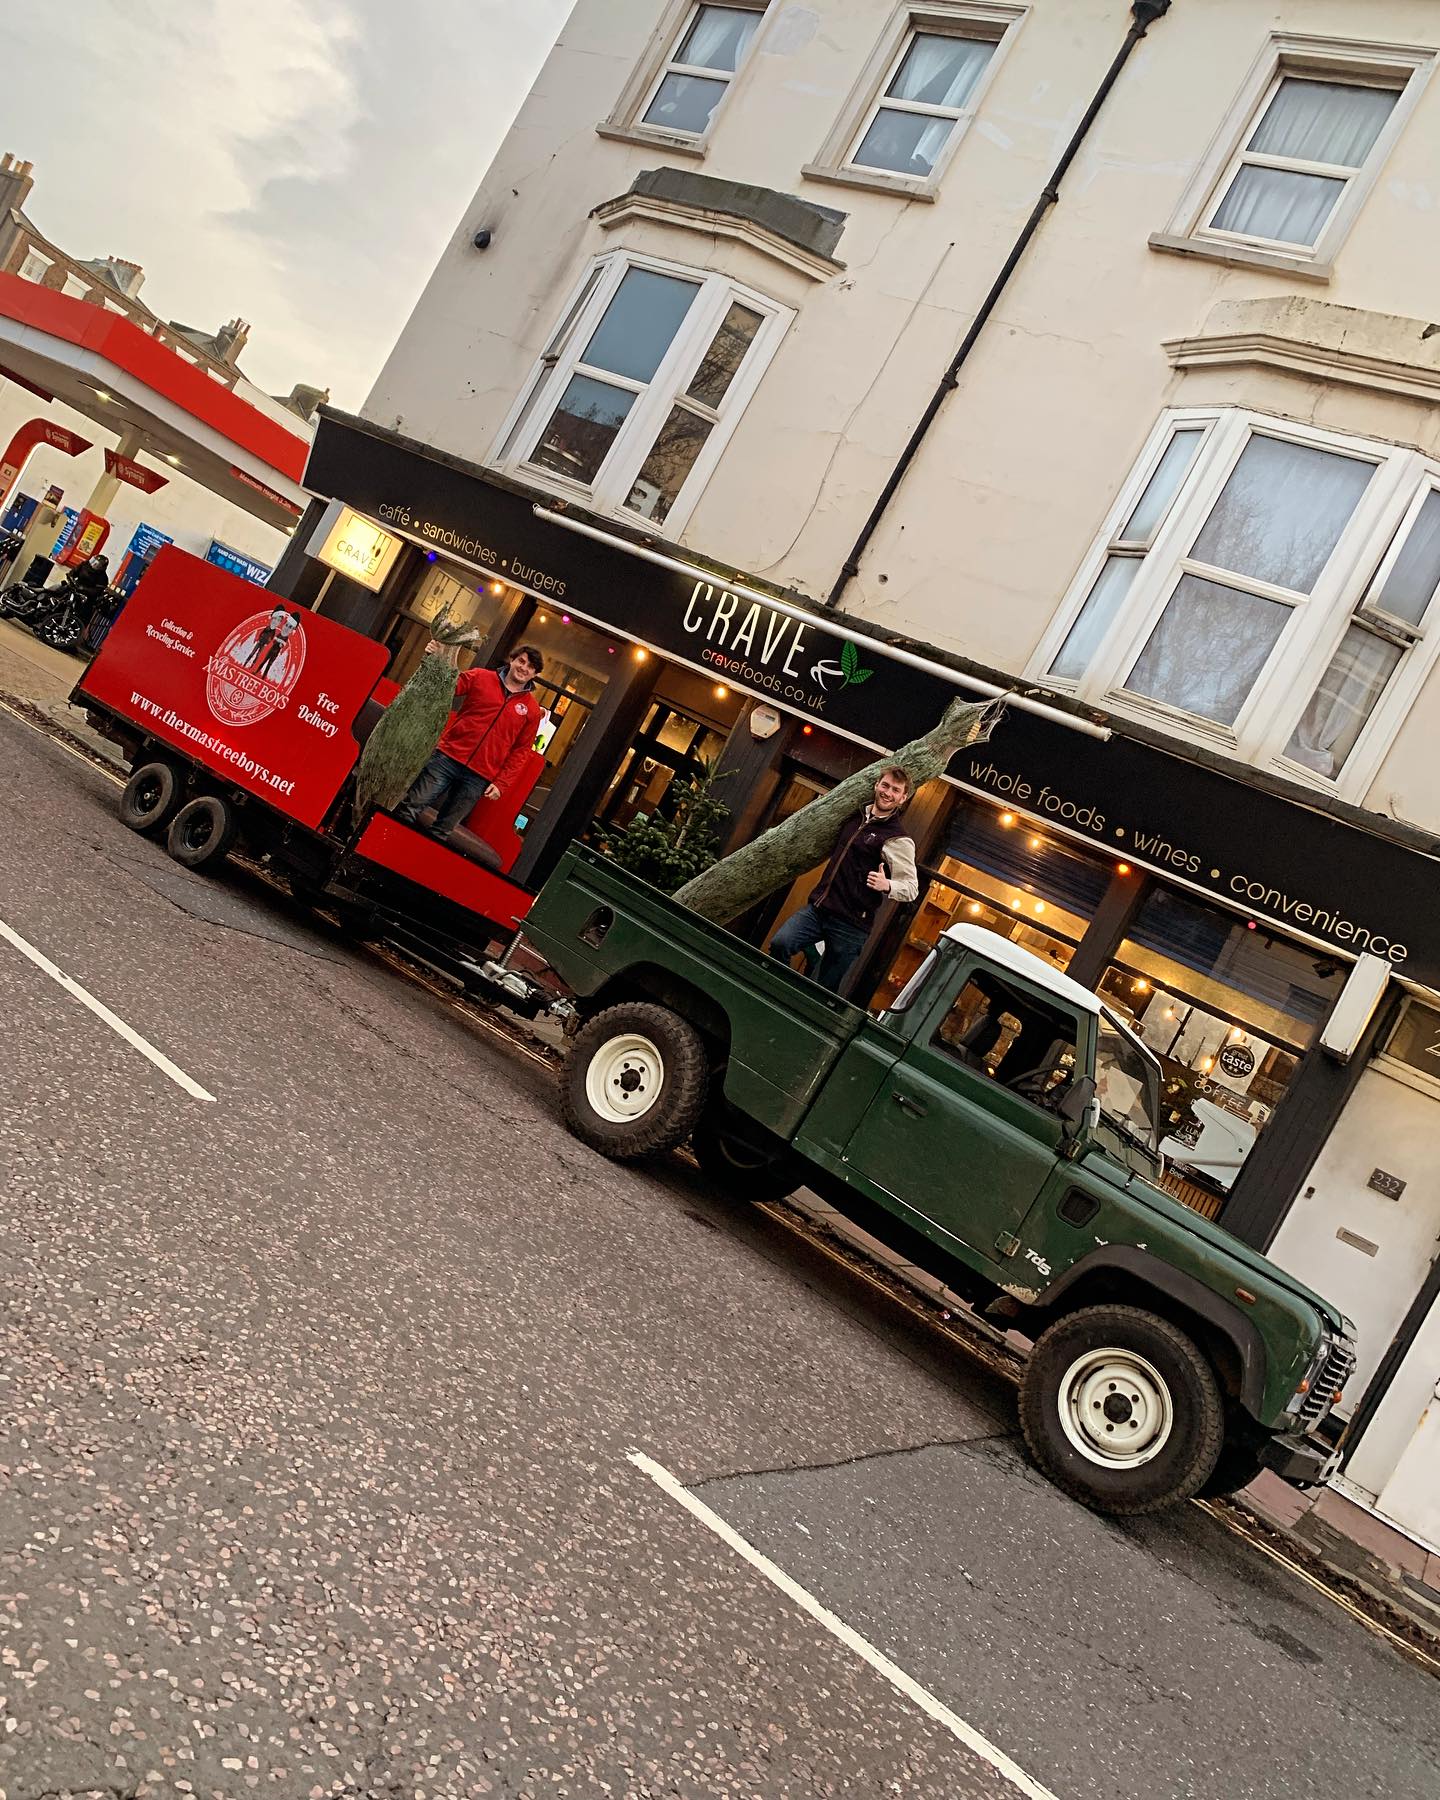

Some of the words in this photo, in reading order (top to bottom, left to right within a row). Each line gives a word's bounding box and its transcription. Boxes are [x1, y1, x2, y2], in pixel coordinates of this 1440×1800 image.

[336, 540, 376, 570] CRAVE
[379, 502, 410, 526] caffé
[422, 520, 497, 564] sandwiches
[512, 557, 566, 596] burgers
[145, 624, 173, 648] Recycling
[172, 640, 196, 658] Service
[161, 618, 187, 638] Collection
[683, 580, 815, 678] CRAVE
[202, 655, 234, 682] XMAS
[233, 672, 259, 694] TREE
[259, 684, 290, 710] BOYS
[701, 647, 826, 711] cravefoods.co.uk
[317, 692, 340, 714] Free
[298, 704, 338, 738] Delivery
[130, 691, 295, 796] www.thexmastreeboys.net
[970, 761, 1032, 799] whole
[1037, 787, 1105, 831] foods
[1135, 829, 1201, 873] wines
[1231, 874, 1408, 963] convenience
[1221, 1053, 1252, 1072] taste
[1194, 1080, 1243, 1109] COFFEE
[1374, 1173, 1400, 1193] 232
[1025, 1248, 1052, 1276] Td5
